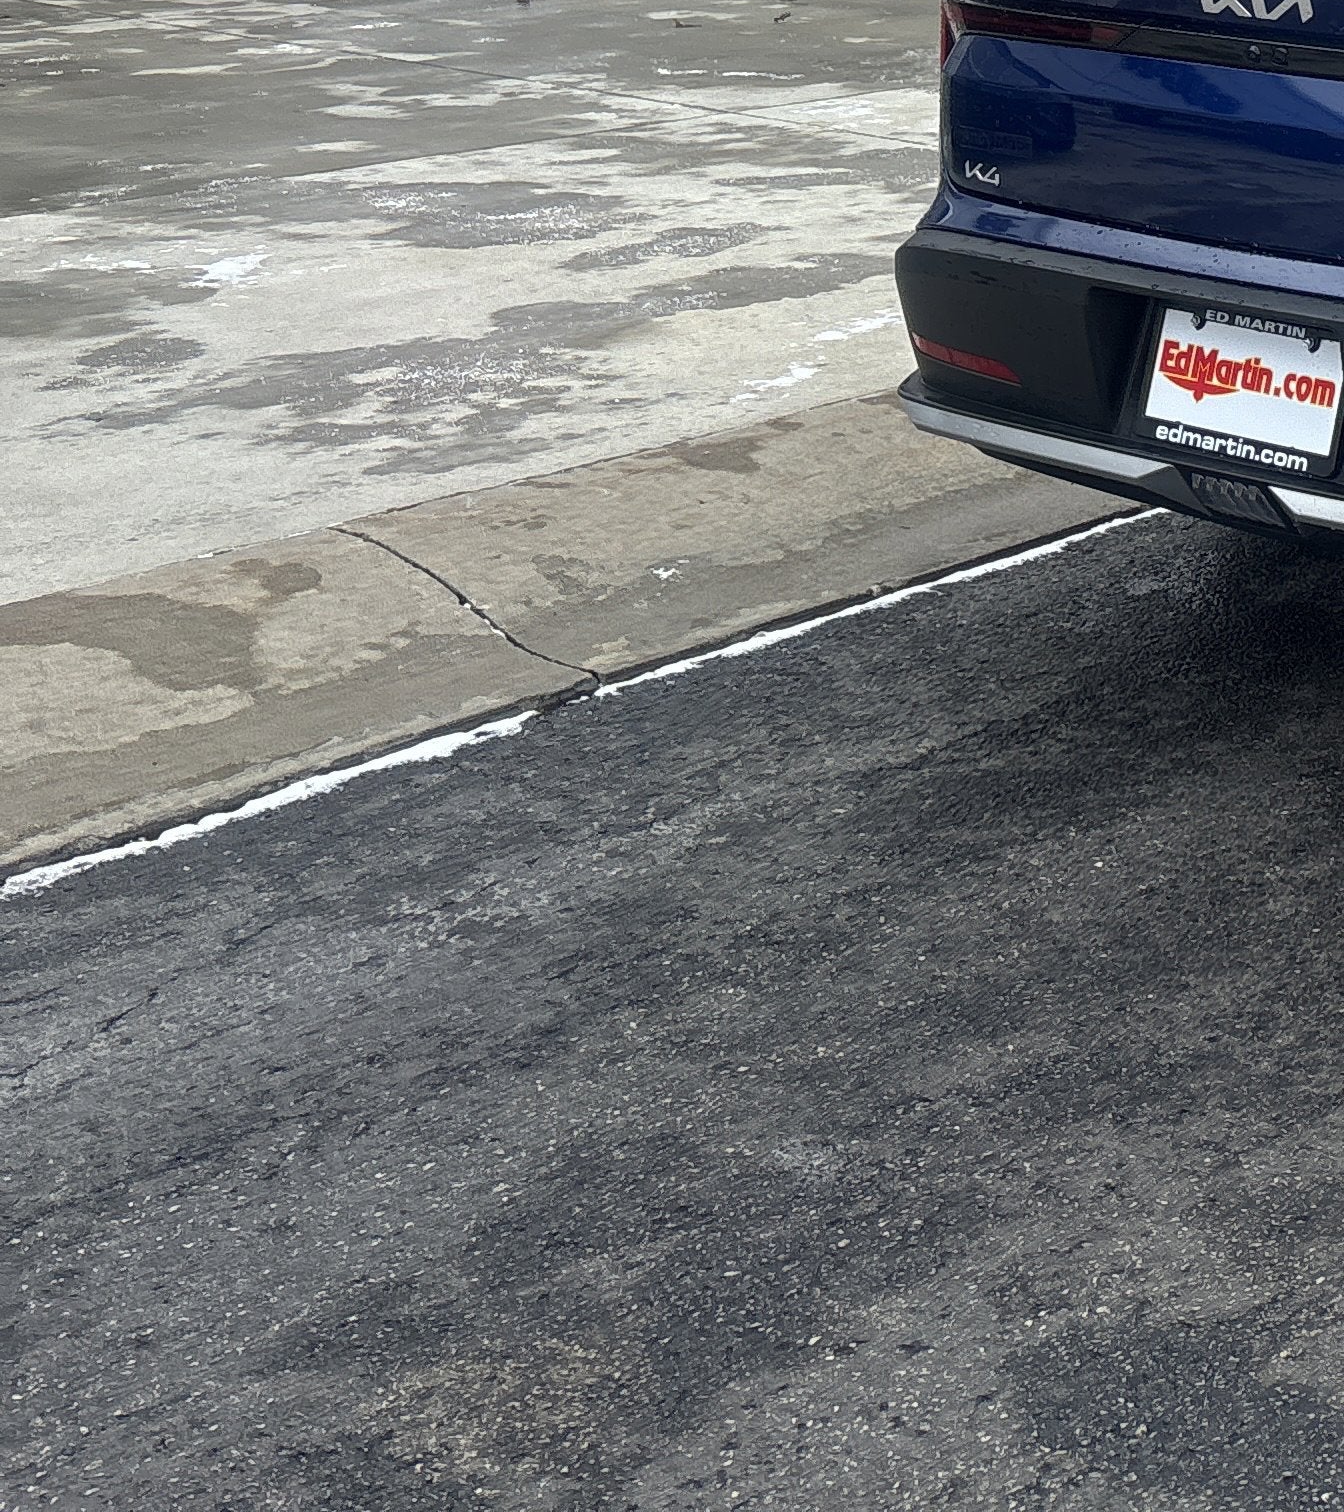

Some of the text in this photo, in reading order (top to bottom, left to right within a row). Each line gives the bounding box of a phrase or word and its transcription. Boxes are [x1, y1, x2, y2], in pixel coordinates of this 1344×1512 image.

[964, 159, 1000, 187] K4
[1204, 309, 1306, 338] ED MARTIN
[1155, 424, 1308, 472] edmartin.com
